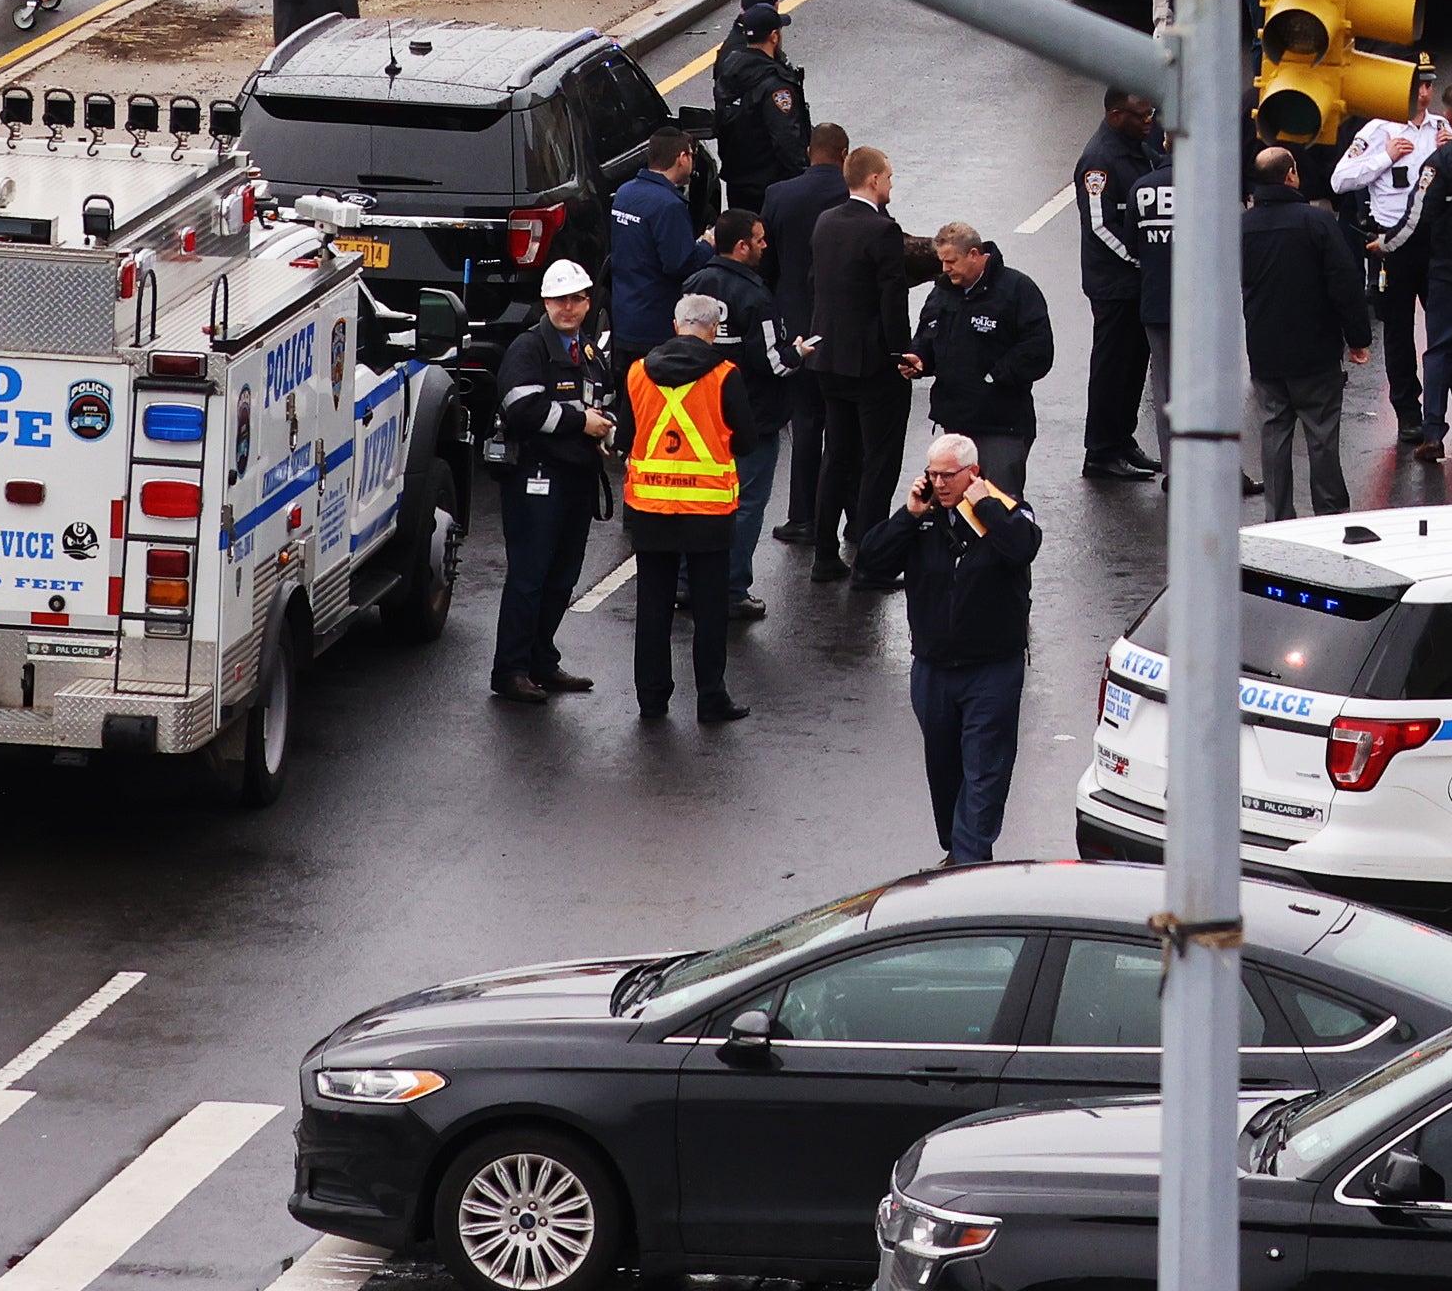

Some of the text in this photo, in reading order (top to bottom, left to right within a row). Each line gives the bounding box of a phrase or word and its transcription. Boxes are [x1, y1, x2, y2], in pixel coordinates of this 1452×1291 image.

[71, 379, 111, 400] POLICE
[15, 578, 84, 593] FEET
[55, 645, 100, 657] PAL CARES
[1121, 650, 1163, 680] NYPD
[1264, 800, 1304, 818] PAL CARES
